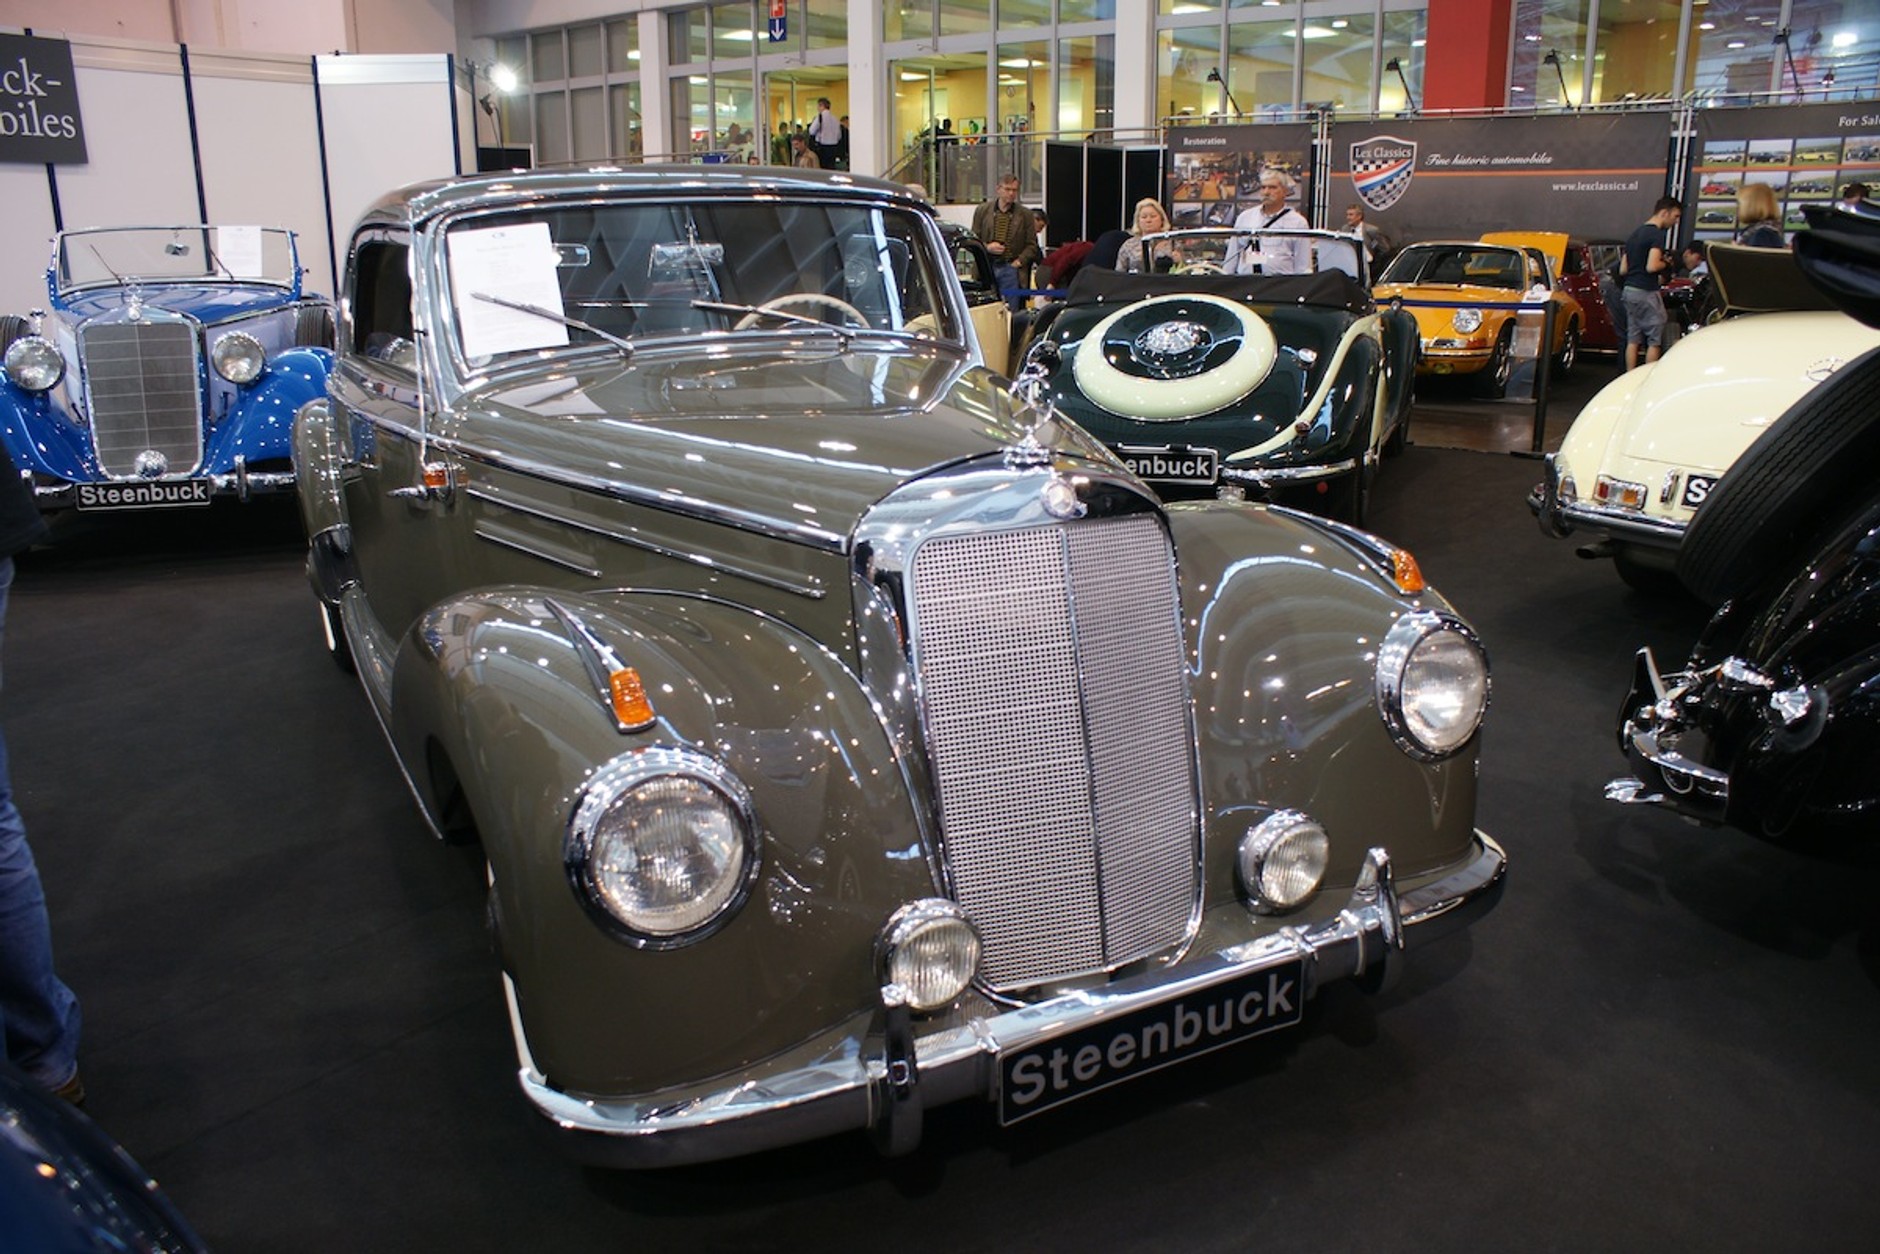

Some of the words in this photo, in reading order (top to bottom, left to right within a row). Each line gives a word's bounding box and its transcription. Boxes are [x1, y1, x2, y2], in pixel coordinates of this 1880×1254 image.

[0, 58, 61, 96] ck-
[1838, 115, 1858, 127] For
[1183, 136, 1227, 146] Restoration
[1355, 147, 1372, 158] Lex
[1373, 147, 1412, 158] Classics
[1425, 153, 1450, 166] Fine
[1451, 154, 1490, 166] historic
[1491, 152, 1553, 165] automobiles
[1552, 181, 1639, 191] www.lexclassics.nl
[80, 482, 206, 505] Steenbuck
[1011, 973, 1295, 1105] Steenbuck
